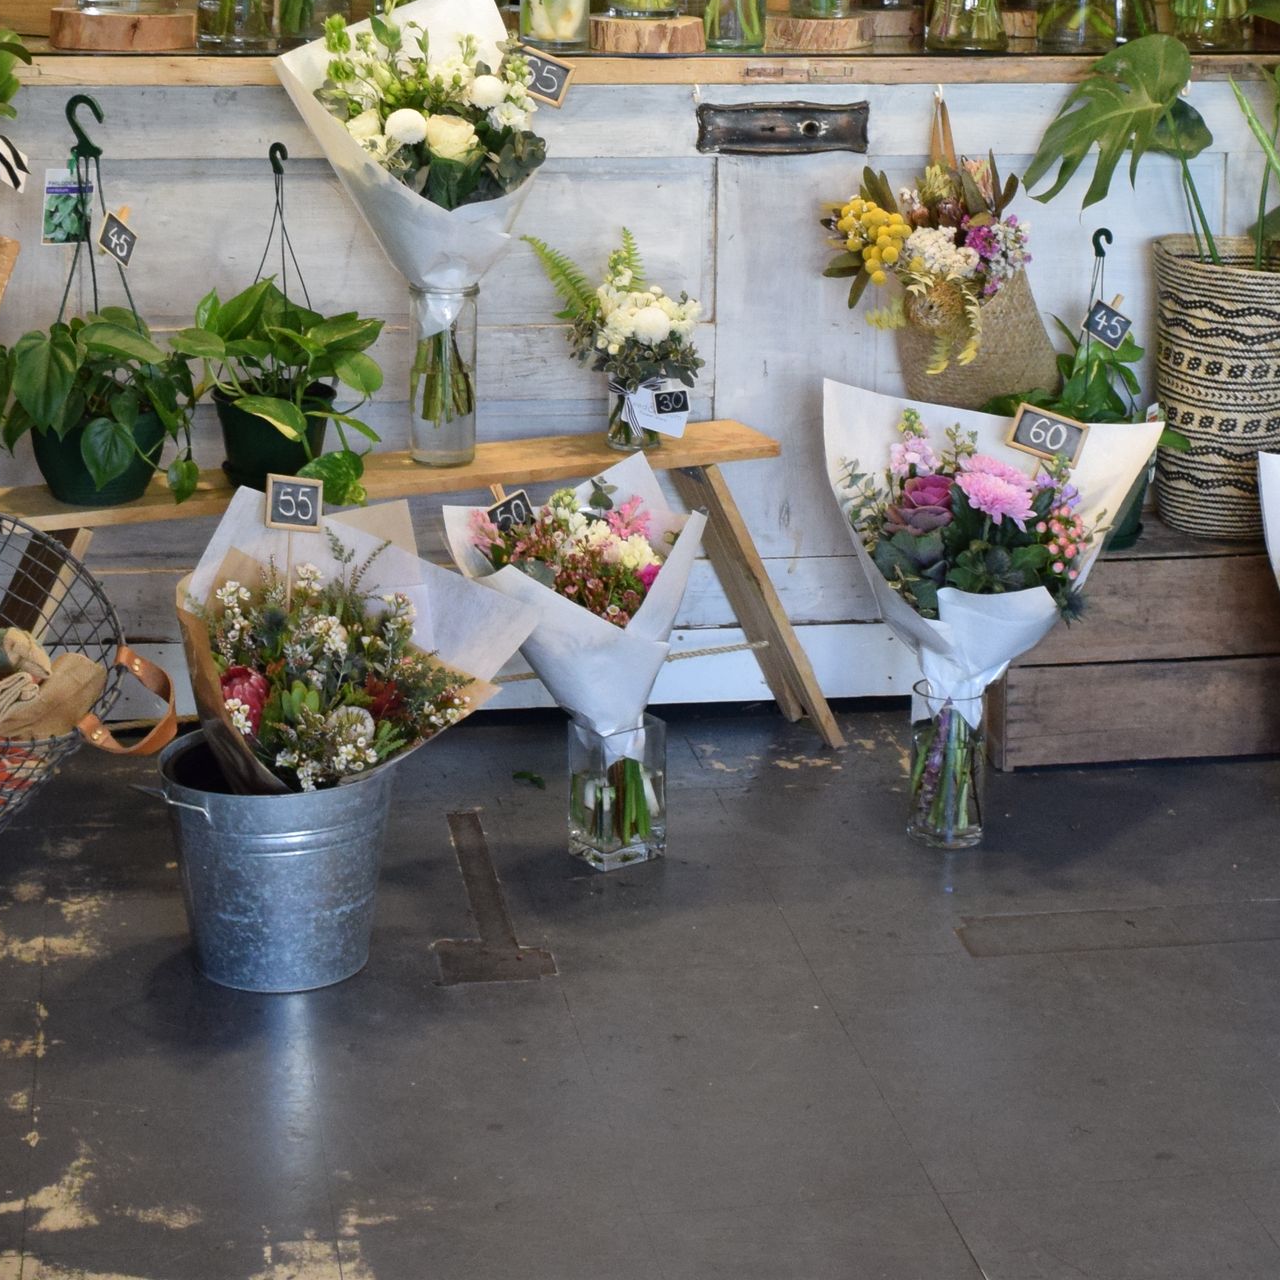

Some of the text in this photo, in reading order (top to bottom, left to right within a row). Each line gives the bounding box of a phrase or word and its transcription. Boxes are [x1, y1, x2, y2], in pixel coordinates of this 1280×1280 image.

[108, 226, 132, 257] 45
[1094, 310, 1126, 339] 45
[660, 391, 685, 411] 30
[1029, 417, 1068, 450] 60
[278, 487, 313, 520] 55
[496, 499, 527, 527] 50
